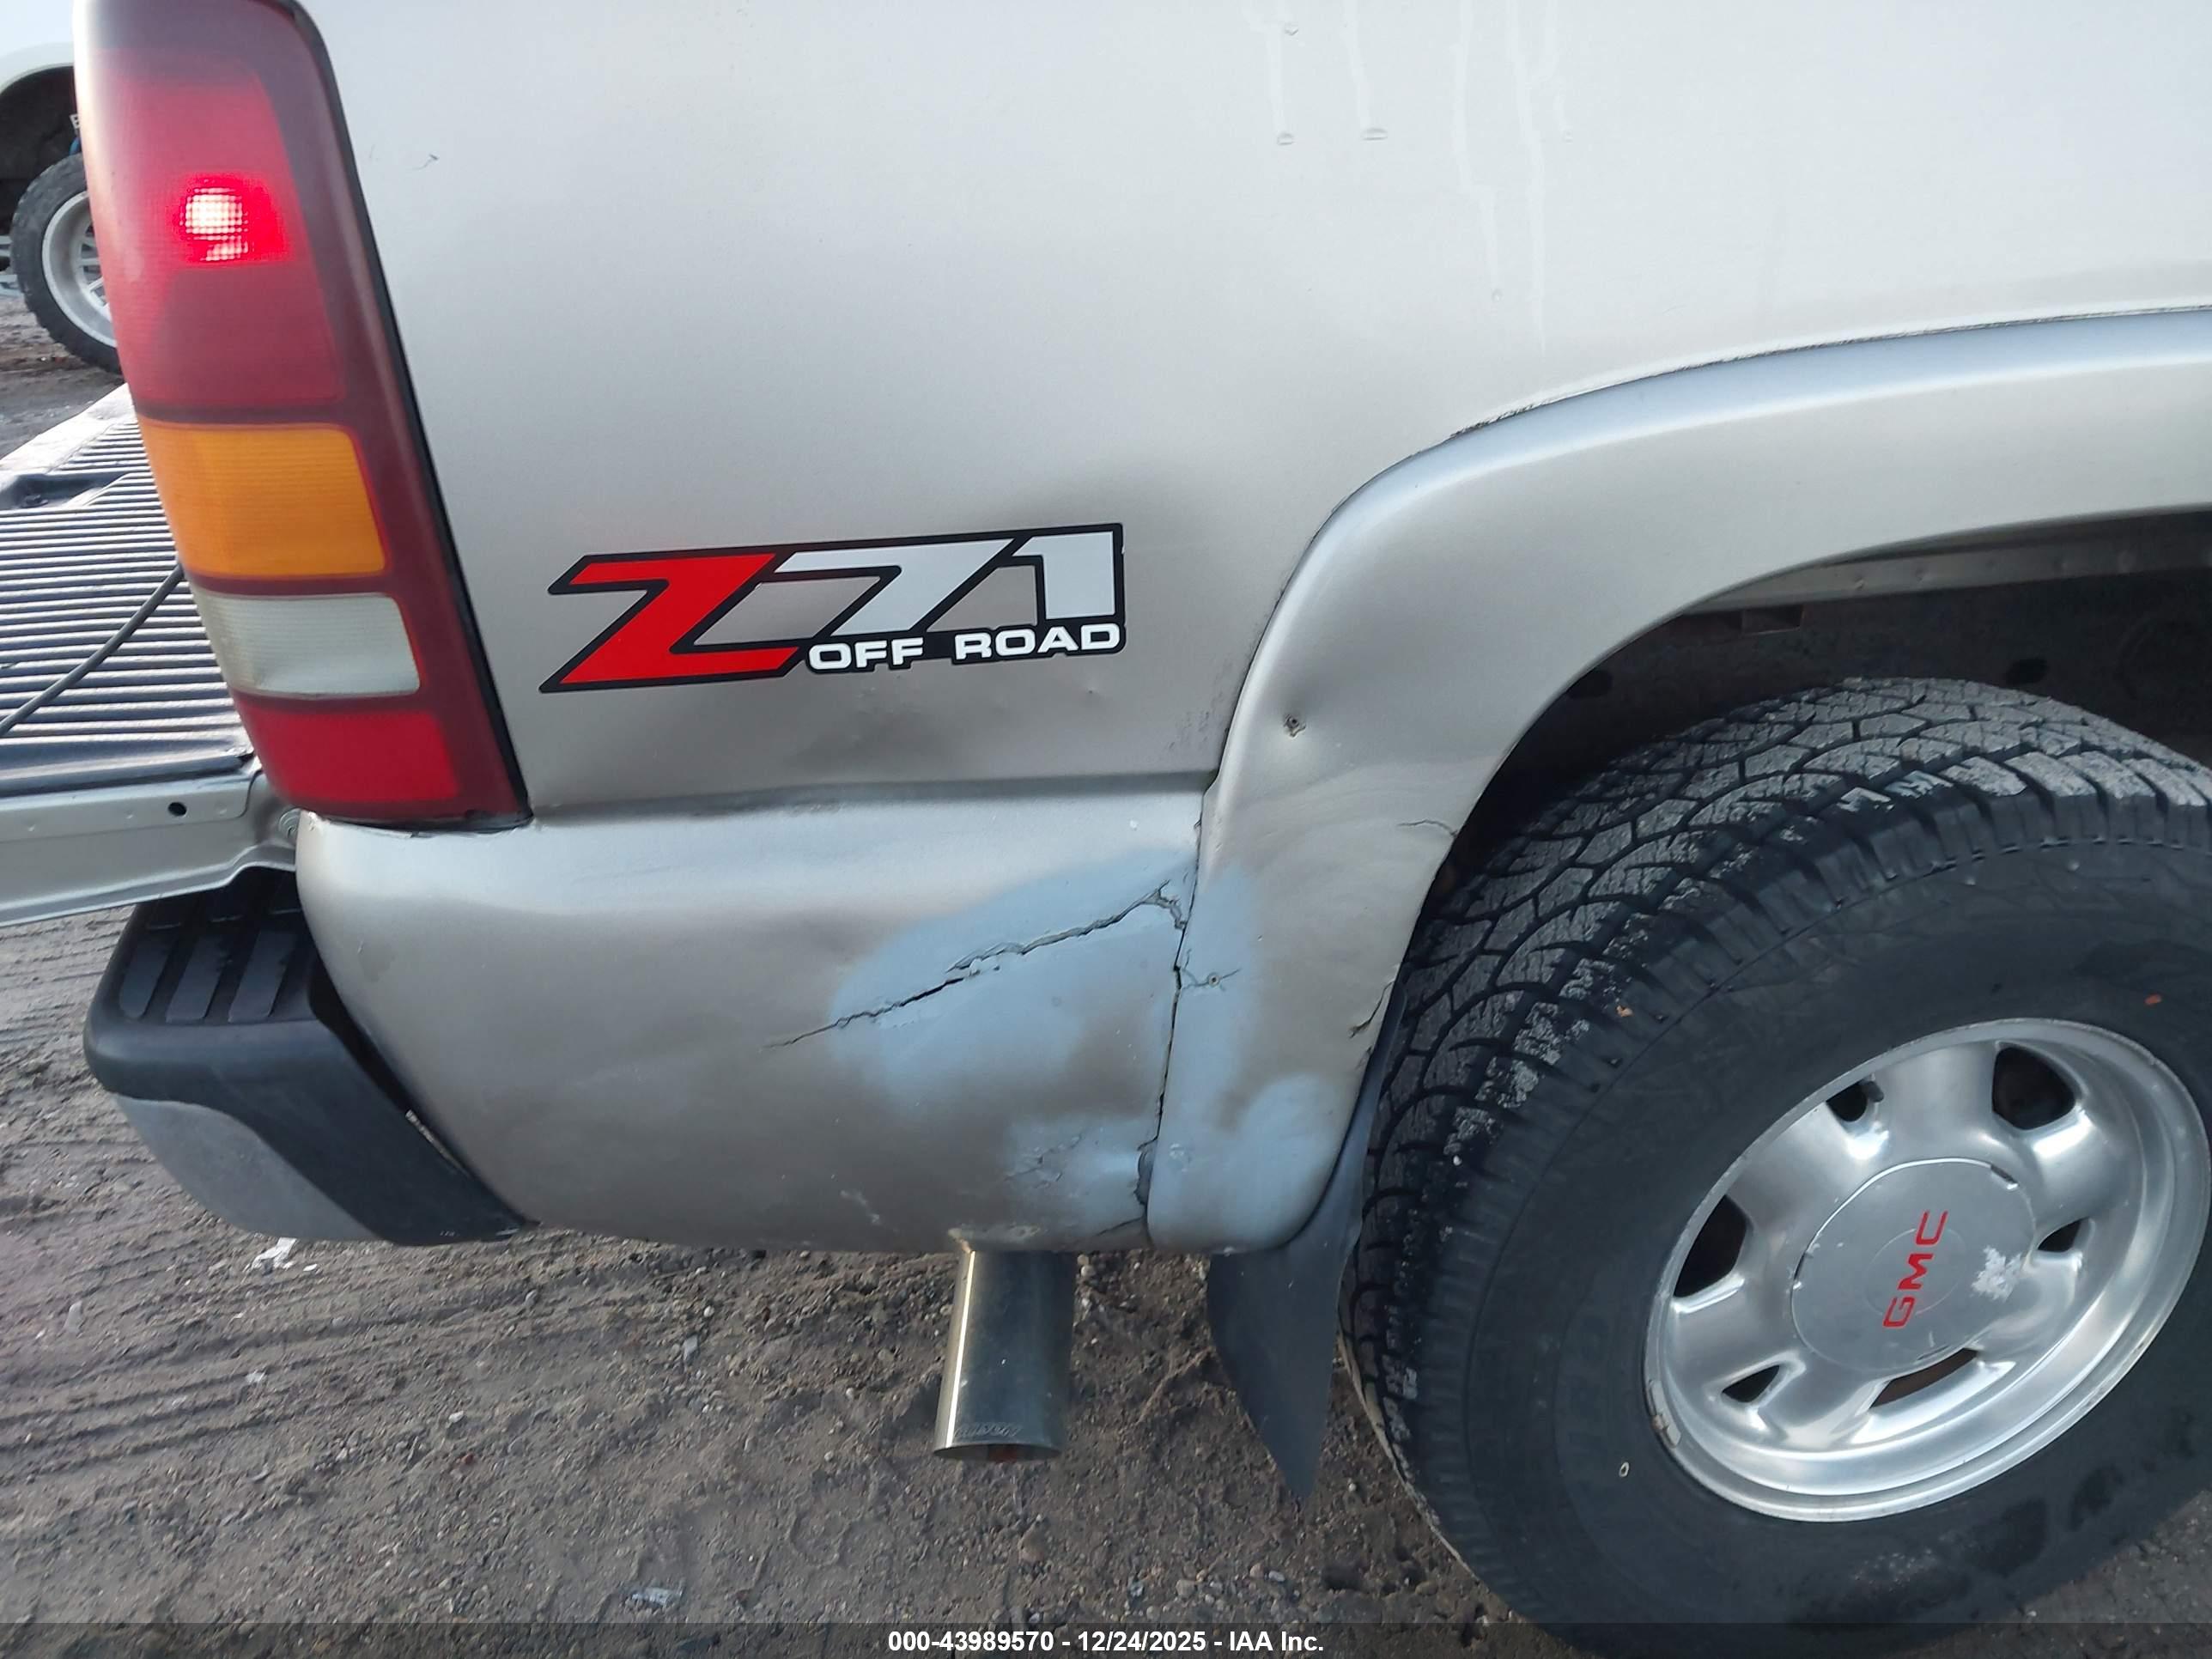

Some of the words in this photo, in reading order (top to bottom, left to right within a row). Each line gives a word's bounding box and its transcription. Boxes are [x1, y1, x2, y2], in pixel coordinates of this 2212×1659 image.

[541, 523, 1124, 692] Z71
[807, 637, 924, 672] OFF
[953, 623, 1120, 662] ROAD
[1882, 1209, 1948, 1328] GMC
